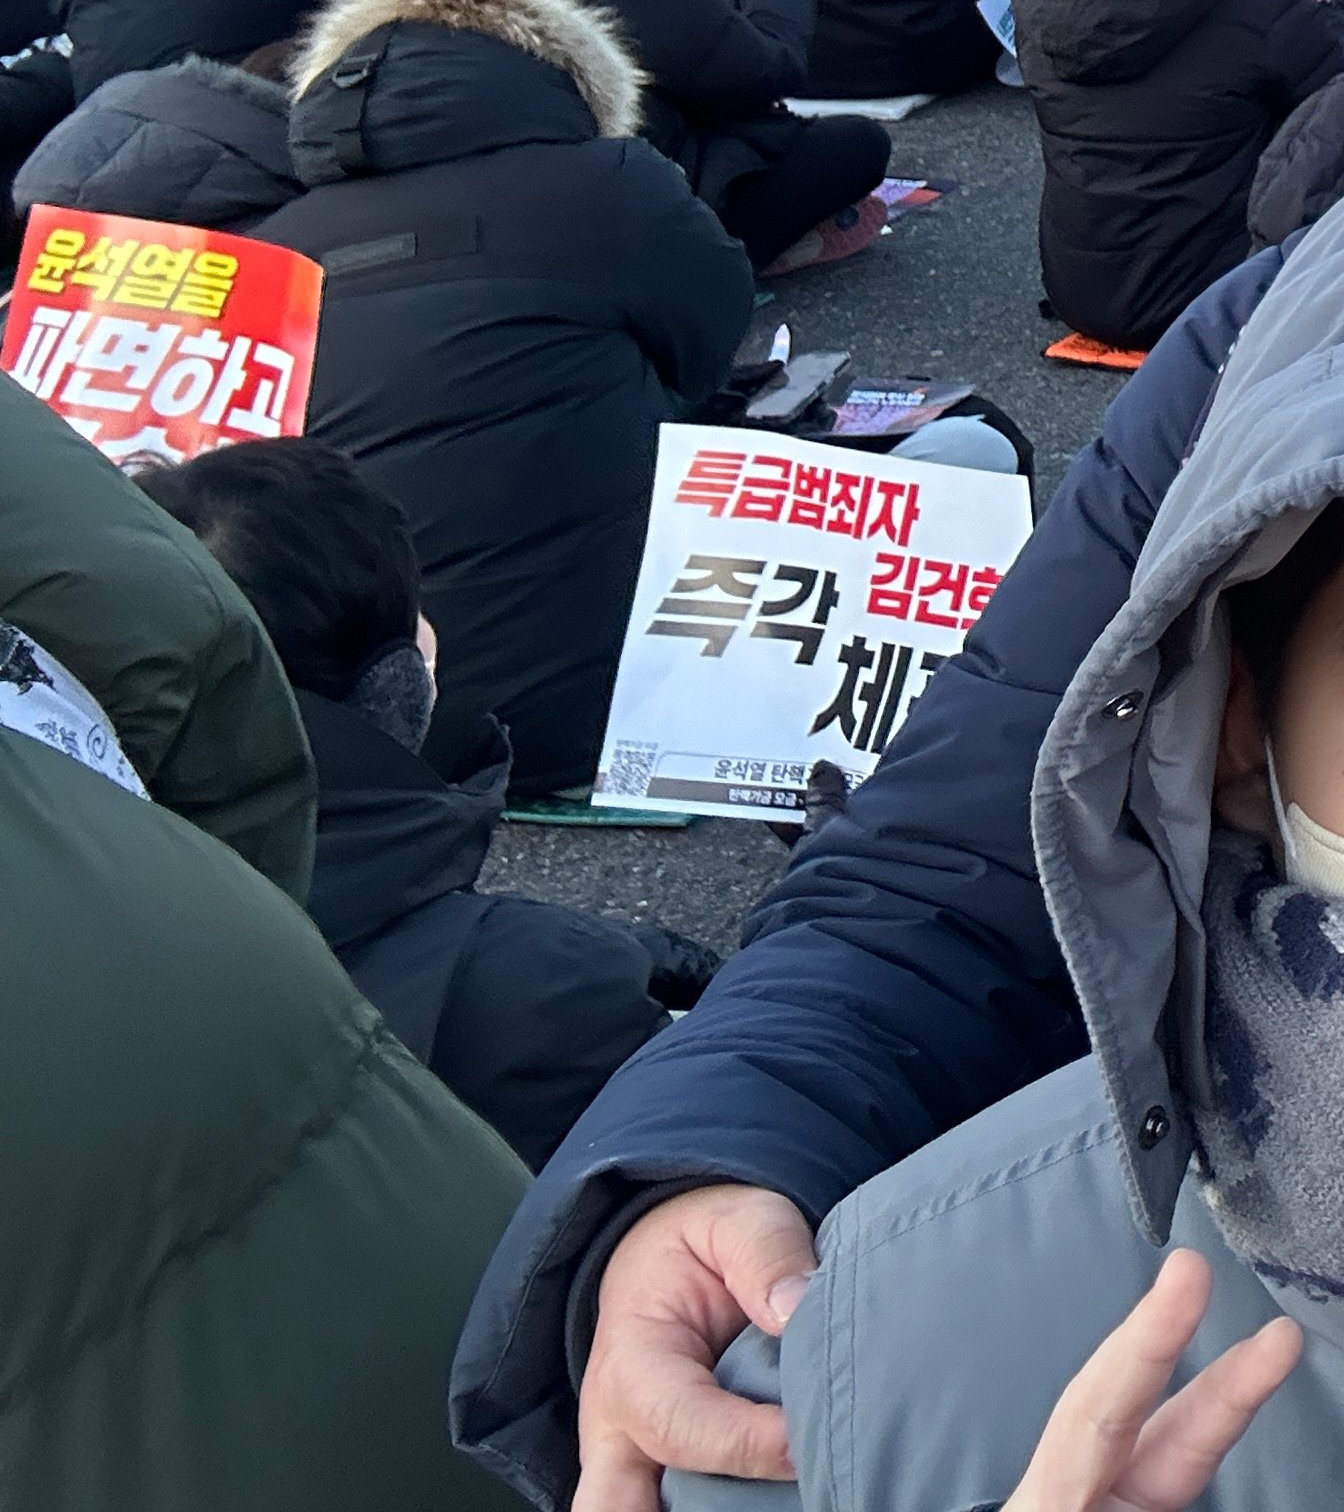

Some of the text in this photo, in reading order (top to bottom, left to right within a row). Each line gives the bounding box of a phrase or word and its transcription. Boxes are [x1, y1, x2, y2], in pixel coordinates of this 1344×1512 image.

[28, 228, 239, 319] 윤석열을
[11, 305, 296, 438] 파면하고
[674, 449, 921, 547] 특급범죄자
[646, 553, 840, 666] 즉각
[714, 758, 767, 782] 윤석열
